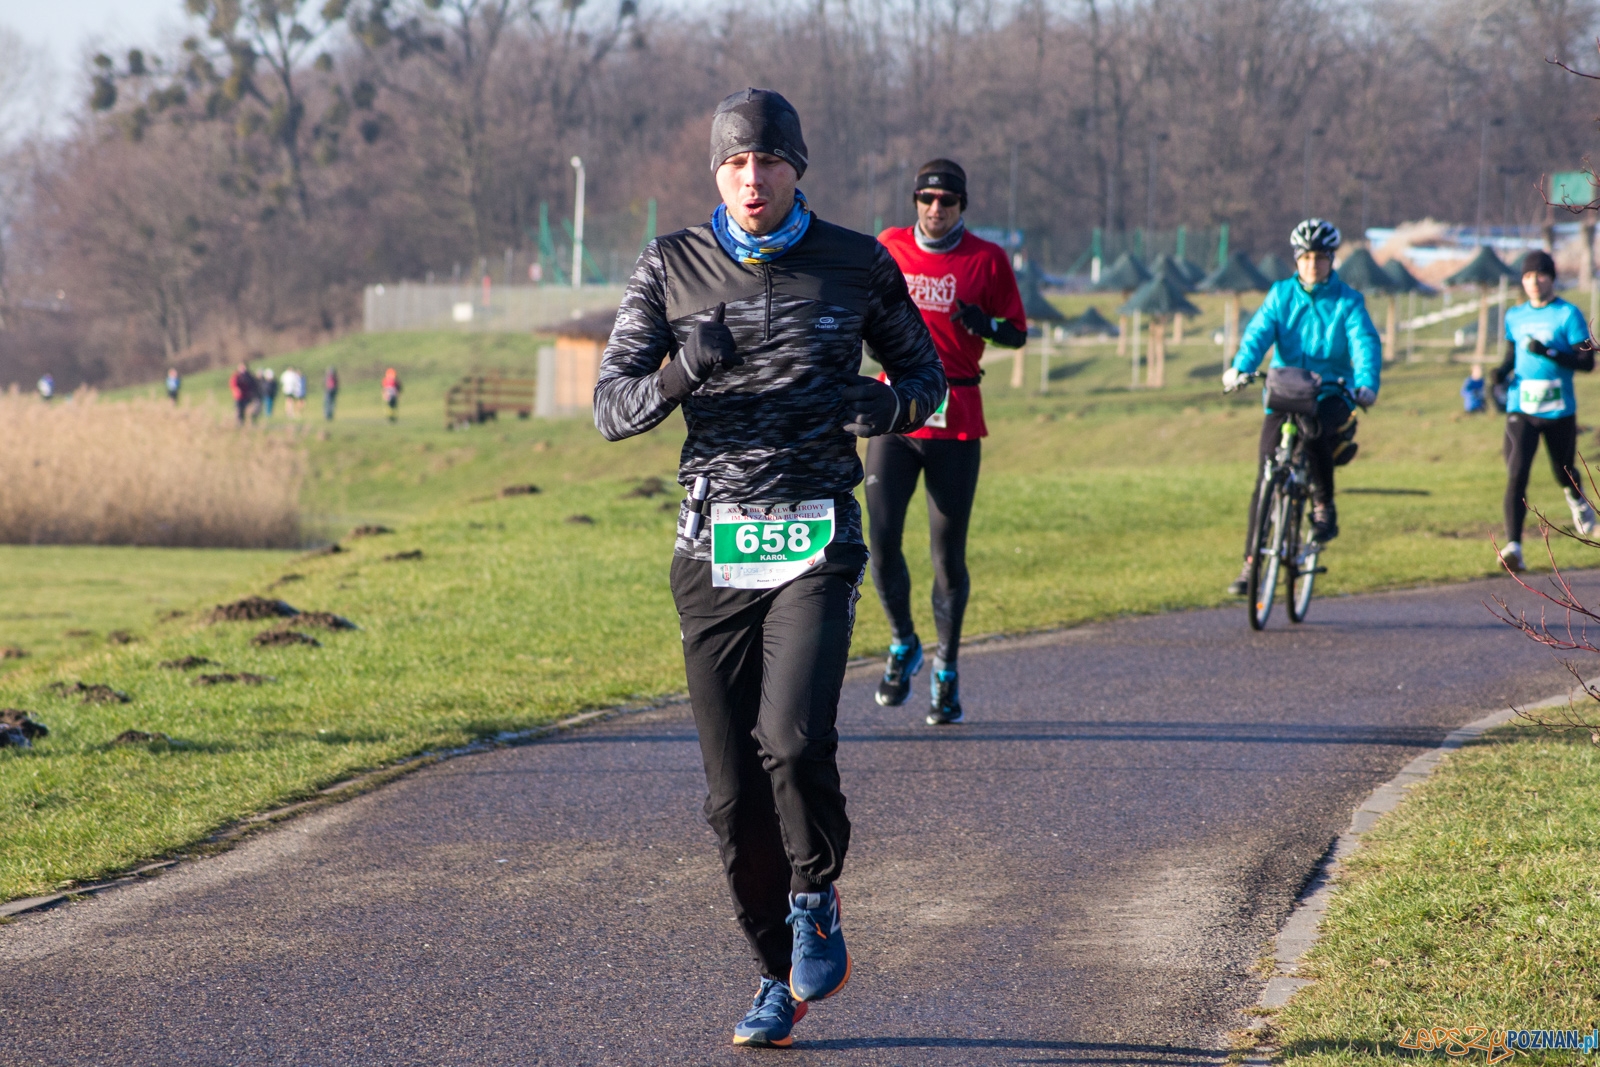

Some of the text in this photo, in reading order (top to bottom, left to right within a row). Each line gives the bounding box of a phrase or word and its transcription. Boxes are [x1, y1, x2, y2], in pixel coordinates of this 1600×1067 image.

[908, 285, 954, 303] ZPIKU
[784, 512, 822, 520] BURGIELA
[735, 523, 812, 554] 658
